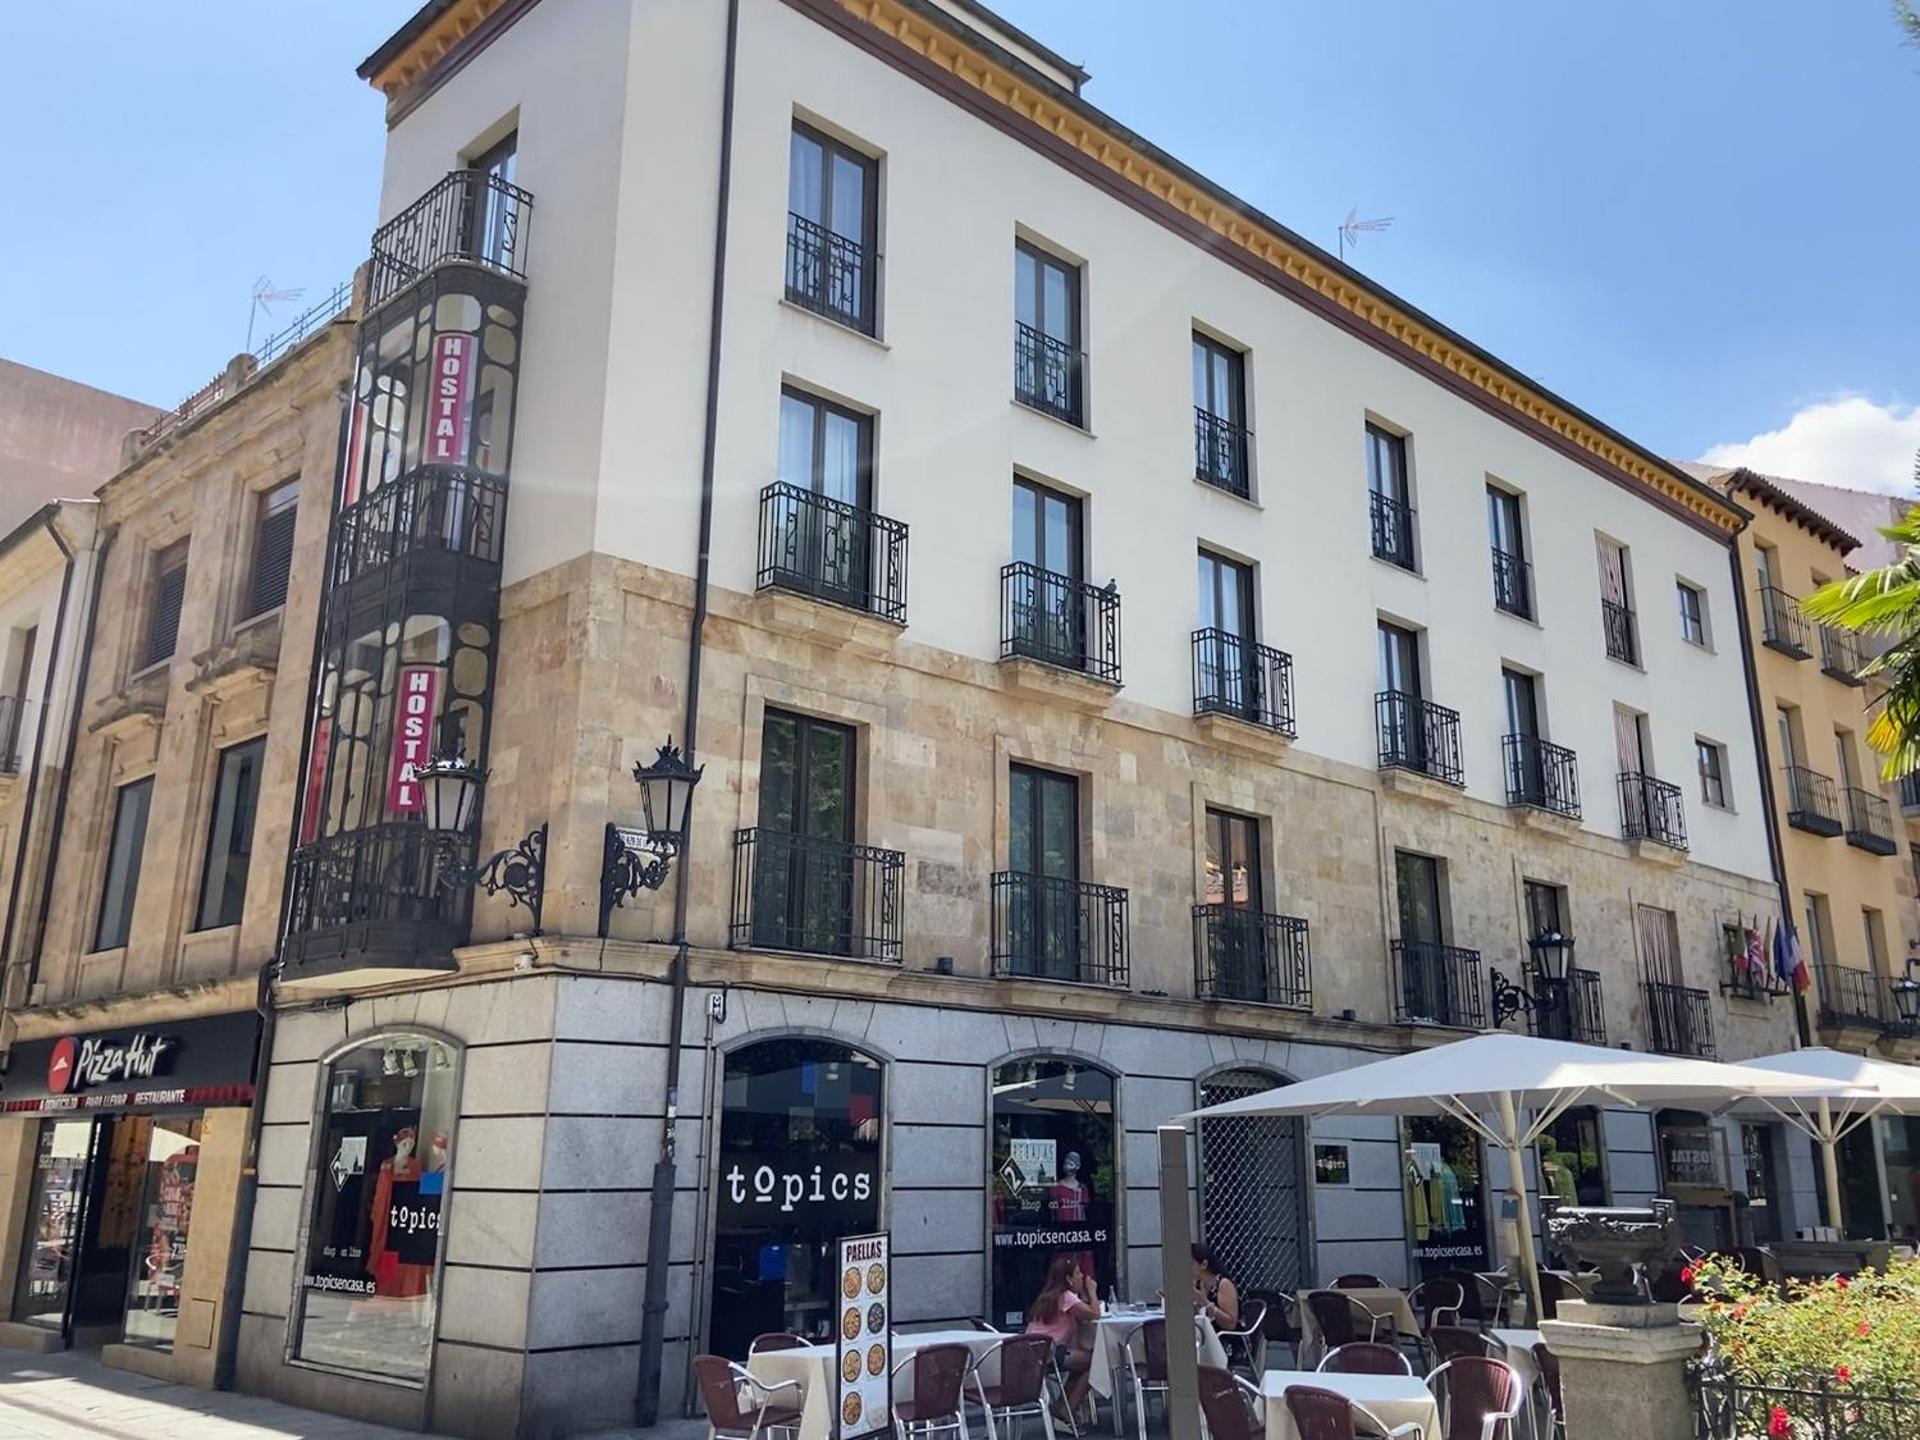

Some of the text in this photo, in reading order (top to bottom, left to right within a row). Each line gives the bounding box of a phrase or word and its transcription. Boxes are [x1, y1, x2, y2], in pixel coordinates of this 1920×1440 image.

[437, 337, 463, 459] HOSTAL
[399, 672, 430, 806] HOSTAL
[72, 1033, 168, 1089] Pizza Hut
[134, 1089, 185, 1106] RESTAURANTE
[727, 1165, 871, 1211] topics
[390, 1205, 441, 1233] topics
[846, 1241, 882, 1263] PAELLAS
